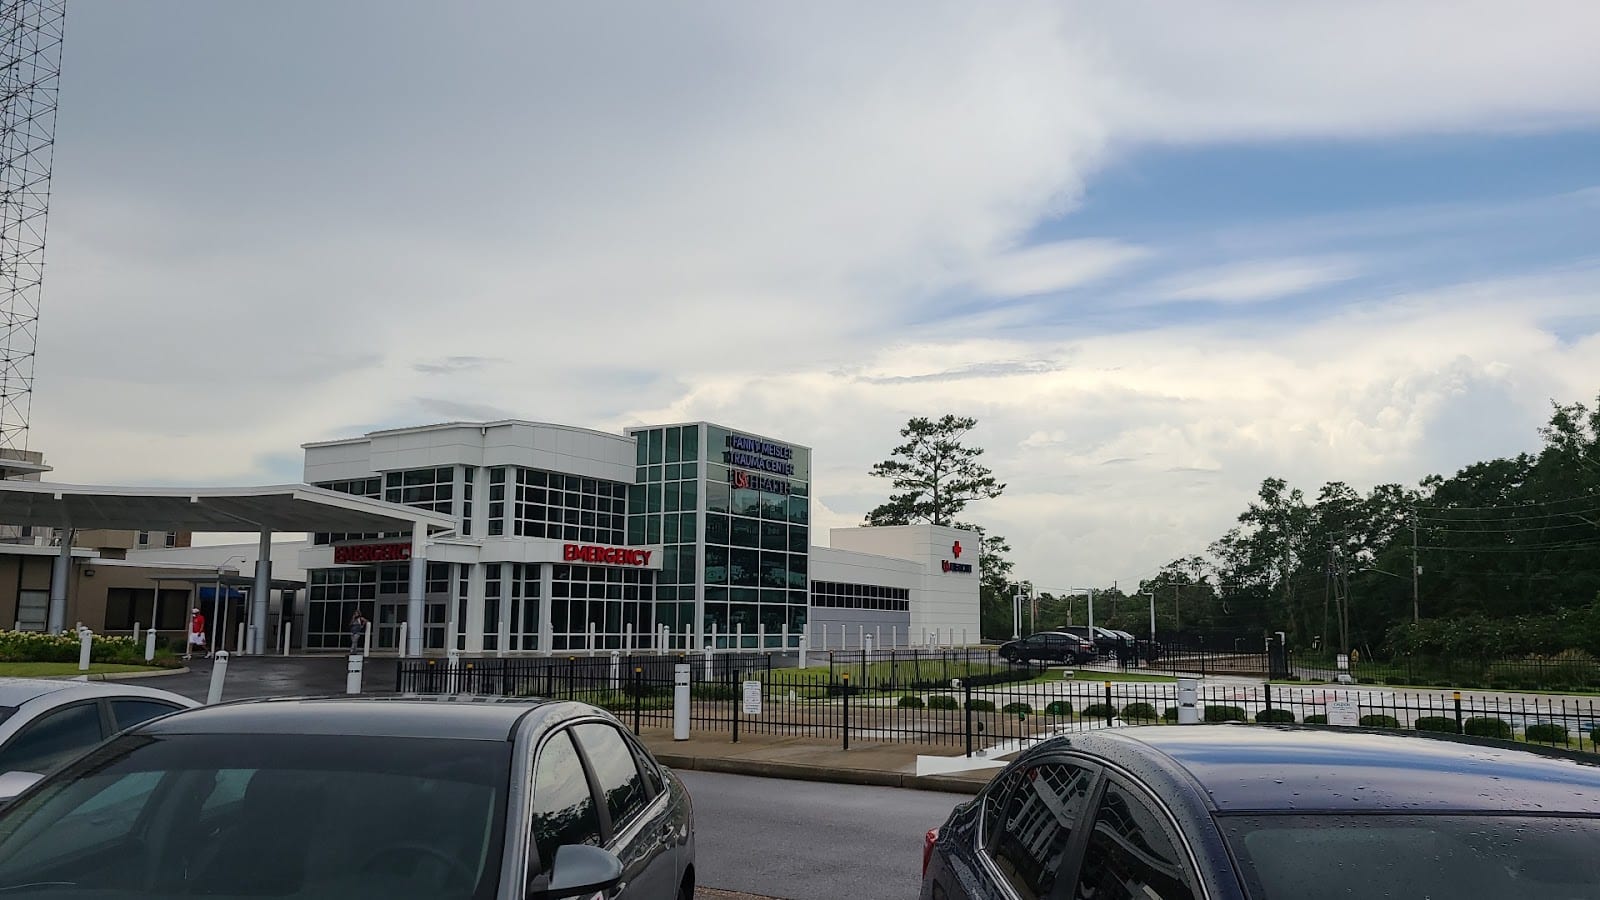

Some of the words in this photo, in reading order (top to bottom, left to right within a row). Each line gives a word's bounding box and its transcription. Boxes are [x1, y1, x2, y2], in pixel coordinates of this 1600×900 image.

[761, 443, 793, 459] MEISLER
[730, 450, 765, 470] TRAUMA
[766, 459, 795, 475] CENTER
[564, 544, 652, 565] EMERGENCY
